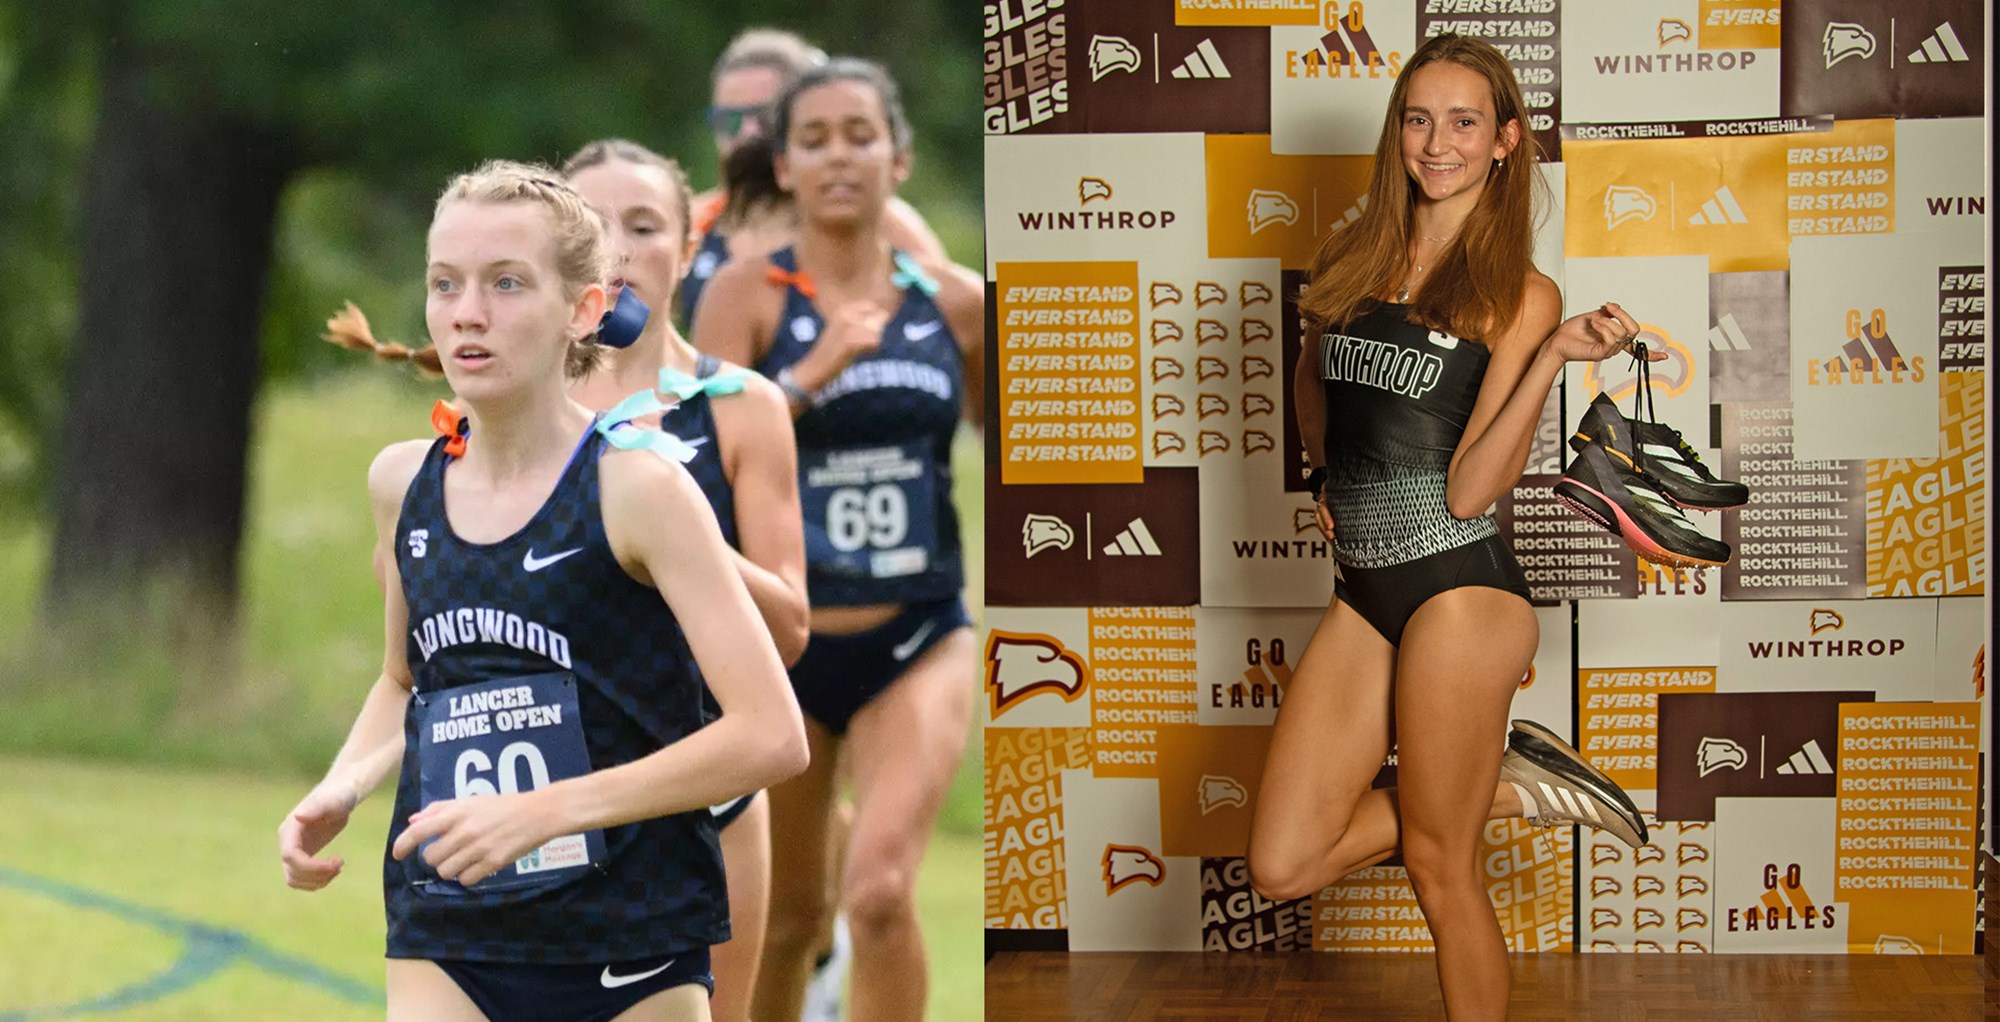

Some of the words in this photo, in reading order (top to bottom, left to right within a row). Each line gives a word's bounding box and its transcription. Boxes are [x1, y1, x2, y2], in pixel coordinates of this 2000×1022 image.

[1324, 1, 1363, 32] GO
[1286, 51, 1401, 78] EAGLES
[1594, 51, 1756, 75] WINTHROP
[1576, 124, 1685, 139] ROCKTHEHILL.
[1705, 118, 1815, 136] ROCKTHEHILL.
[1017, 211, 1176, 230] WINTHROP
[1005, 286, 1133, 303] EVERSTAND
[1005, 309, 1134, 326] EVERSTAND
[1846, 308, 1886, 339] GO
[1006, 332, 1134, 349] EVERSTAND
[1007, 355, 1135, 372] EVERSTAND
[1320, 334, 1443, 399] INTHROP
[1807, 356, 1925, 386] EAGLES
[1008, 378, 1135, 394] EVERSTAND
[1008, 400, 1136, 417] EVERSTAND
[1008, 422, 1136, 439] EVERSTAND
[1009, 445, 1136, 462] EVERSTAND
[1747, 491, 1848, 504] OCKTHEHILL.
[827, 484, 908, 552] 69
[1740, 508, 1848, 521] ROCKTHEHILL.
[1740, 526, 1848, 538] ROCKTHEHILL.
[1233, 541, 1327, 558] WINTH
[1513, 538, 1620, 550] ROCKTHEHILL.
[1740, 543, 1848, 556] ROCKTHEHILL.
[1740, 558, 1848, 570] ROCKTHEHILL.
[1740, 574, 1848, 588] ROCKTHEHILL.
[412, 608, 572, 669] LONGWOOD
[1246, 638, 1284, 666] GO
[1748, 639, 1905, 658] WINTHROP
[1586, 671, 1713, 688] EVERSTAND
[450, 686, 535, 718] LANCER
[432, 716, 491, 744] HOME
[496, 704, 562, 732] OPEN
[1842, 716, 1975, 730] ROCKTHEHILL.
[1842, 736, 1974, 750] ROCKTHEHILL.
[454, 741, 551, 800] 60
[1842, 757, 1974, 770] ROCKTHEHILL.
[1842, 778, 1973, 791] ROCKTHEHILL.
[1841, 798, 1972, 811] ROCKTHEHILL.
[1841, 818, 1971, 831] ROCKTHEHILL.
[1840, 837, 1970, 850] ROCKTHEHILL.
[1840, 856, 1970, 870] ROCKTHEHILL.
[1764, 863, 1801, 890] GO
[1839, 876, 1968, 890] ROCKTHEHILL.
[1728, 905, 1835, 932] EAGLES
